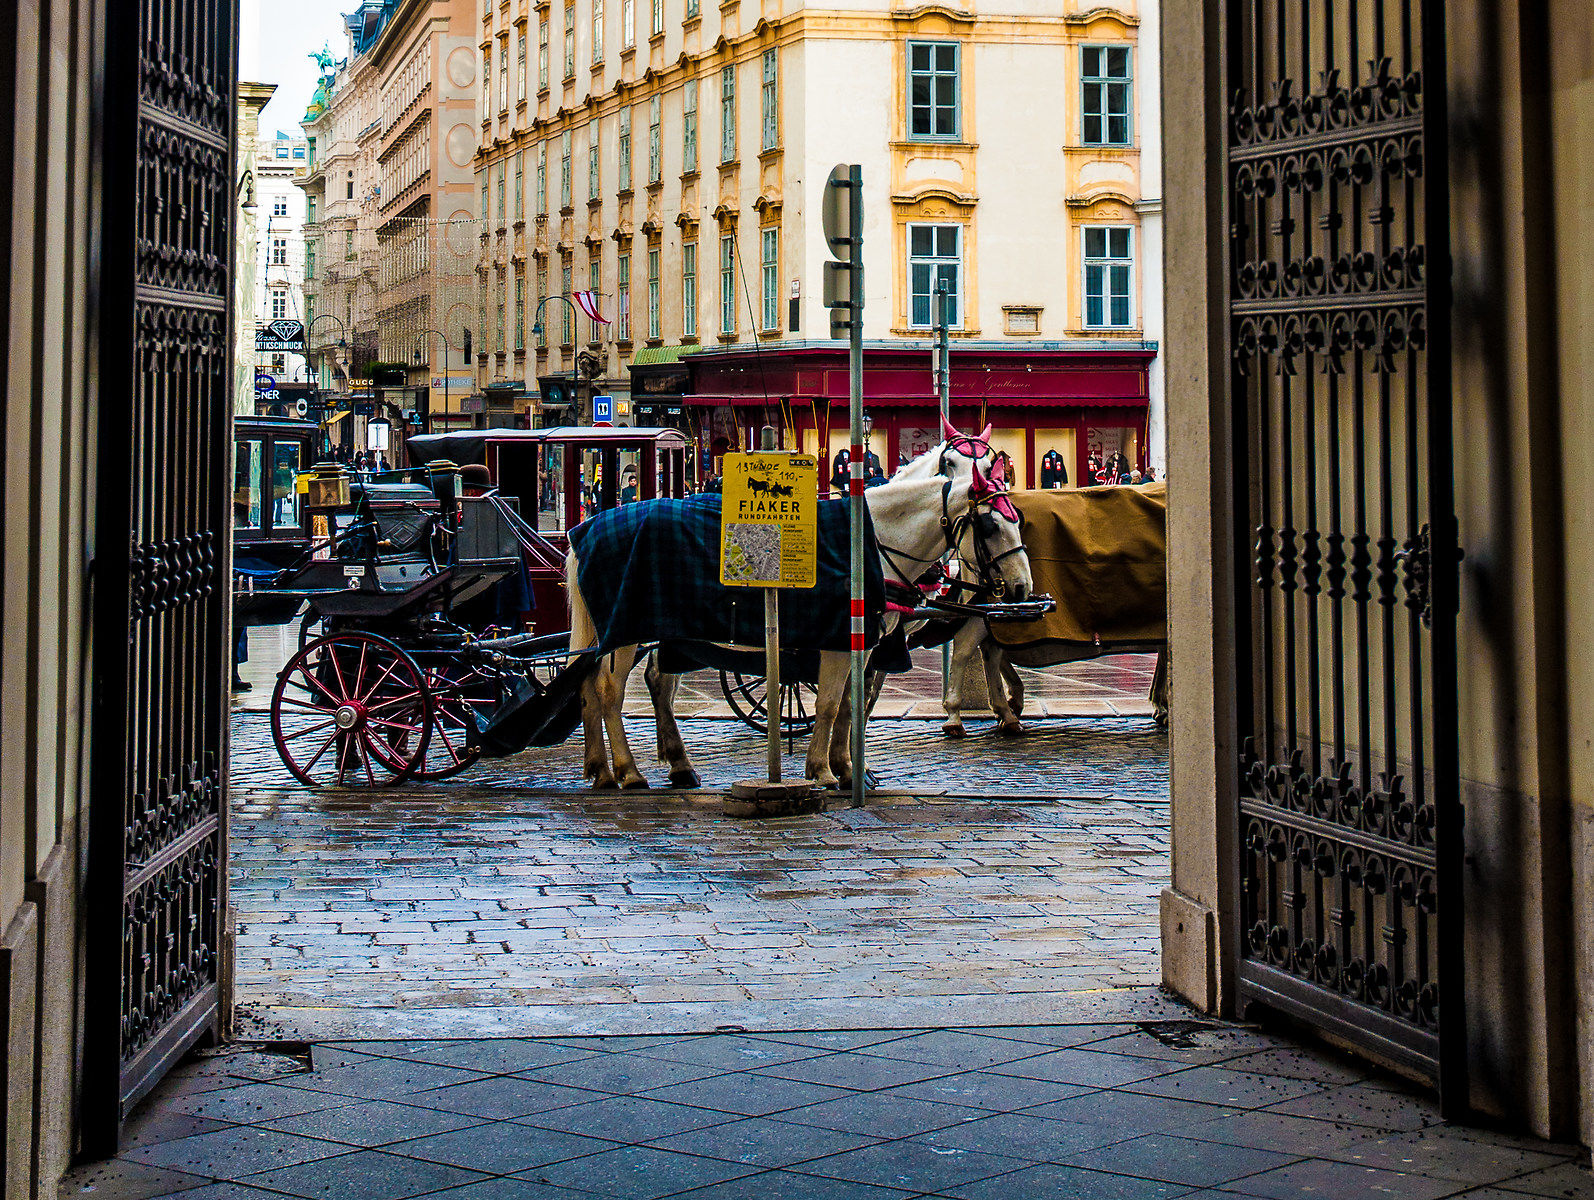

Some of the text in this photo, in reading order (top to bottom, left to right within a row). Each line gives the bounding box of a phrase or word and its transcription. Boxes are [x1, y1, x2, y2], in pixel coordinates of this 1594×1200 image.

[255, 341, 303, 350] NTIKSCHMUCK
[984, 375, 1031, 391] Gentlemen
[254, 390, 280, 400] GNER
[736, 462, 780, 474] 1 STUNDE
[739, 500, 800, 513] FIAKER
[738, 513, 800, 521] RUNDFAHRTEN
